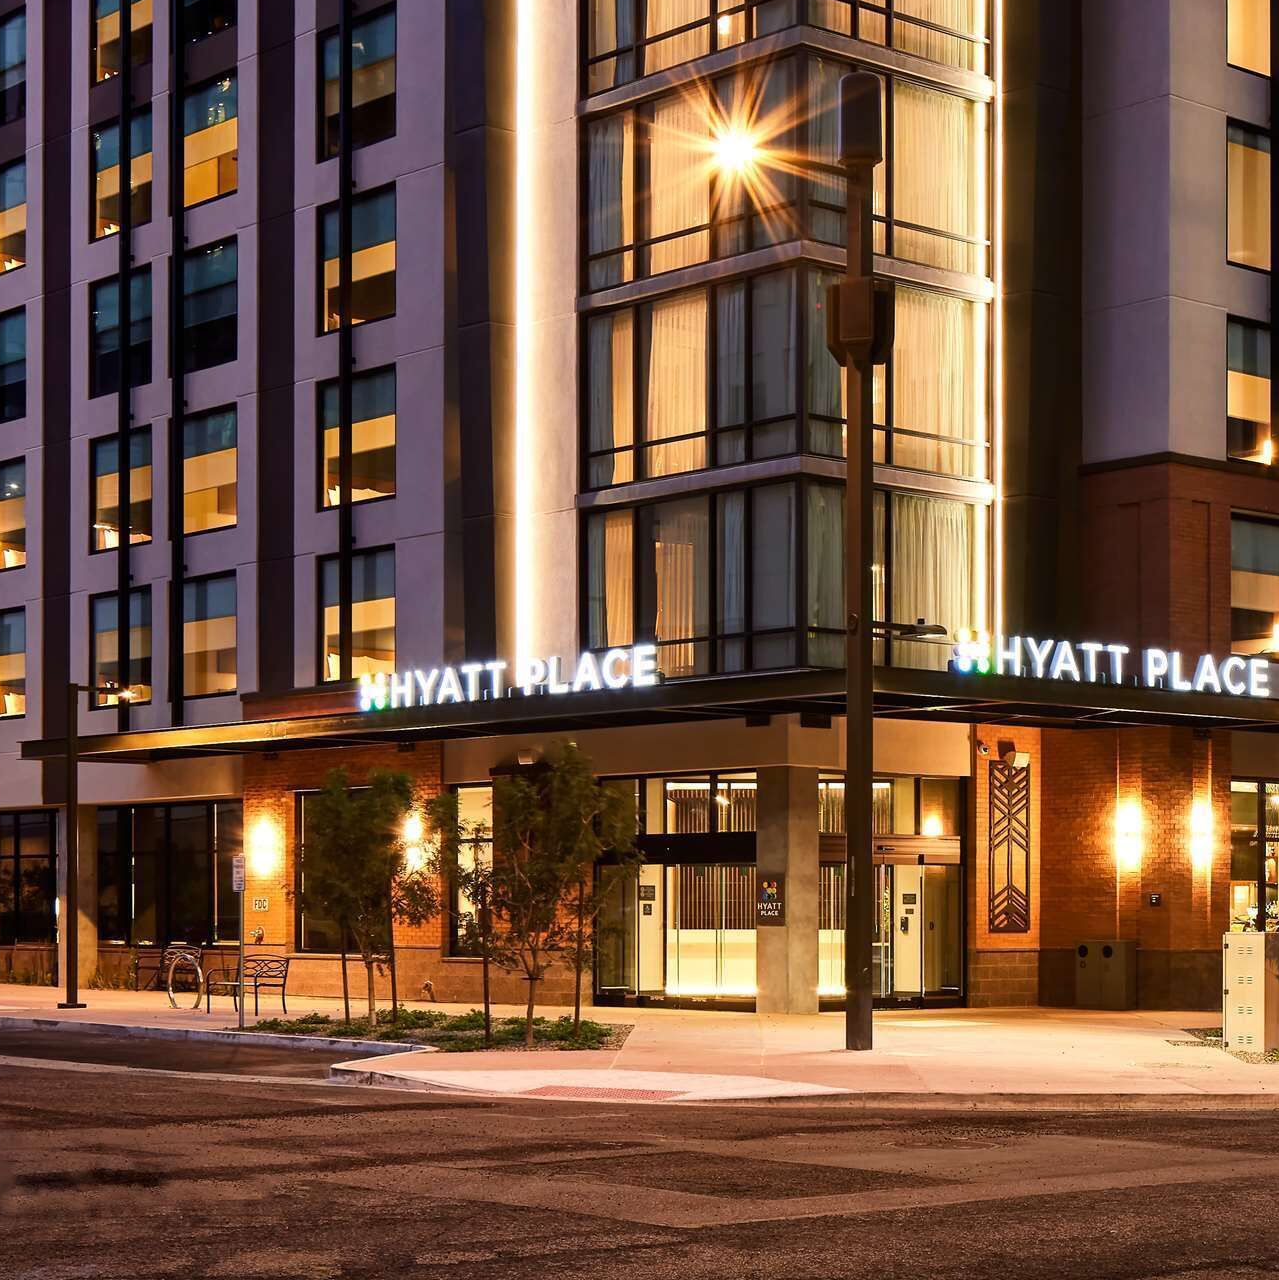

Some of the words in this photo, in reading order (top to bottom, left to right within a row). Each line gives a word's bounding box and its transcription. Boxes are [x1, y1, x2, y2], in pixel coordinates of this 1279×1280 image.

[390, 661, 507, 709] HYATT
[523, 644, 658, 696] PLACE
[995, 634, 1129, 684] HYATT
[1142, 648, 1270, 697] PLACE
[254, 899, 267, 909] FDC
[757, 902, 782, 910] HYATT
